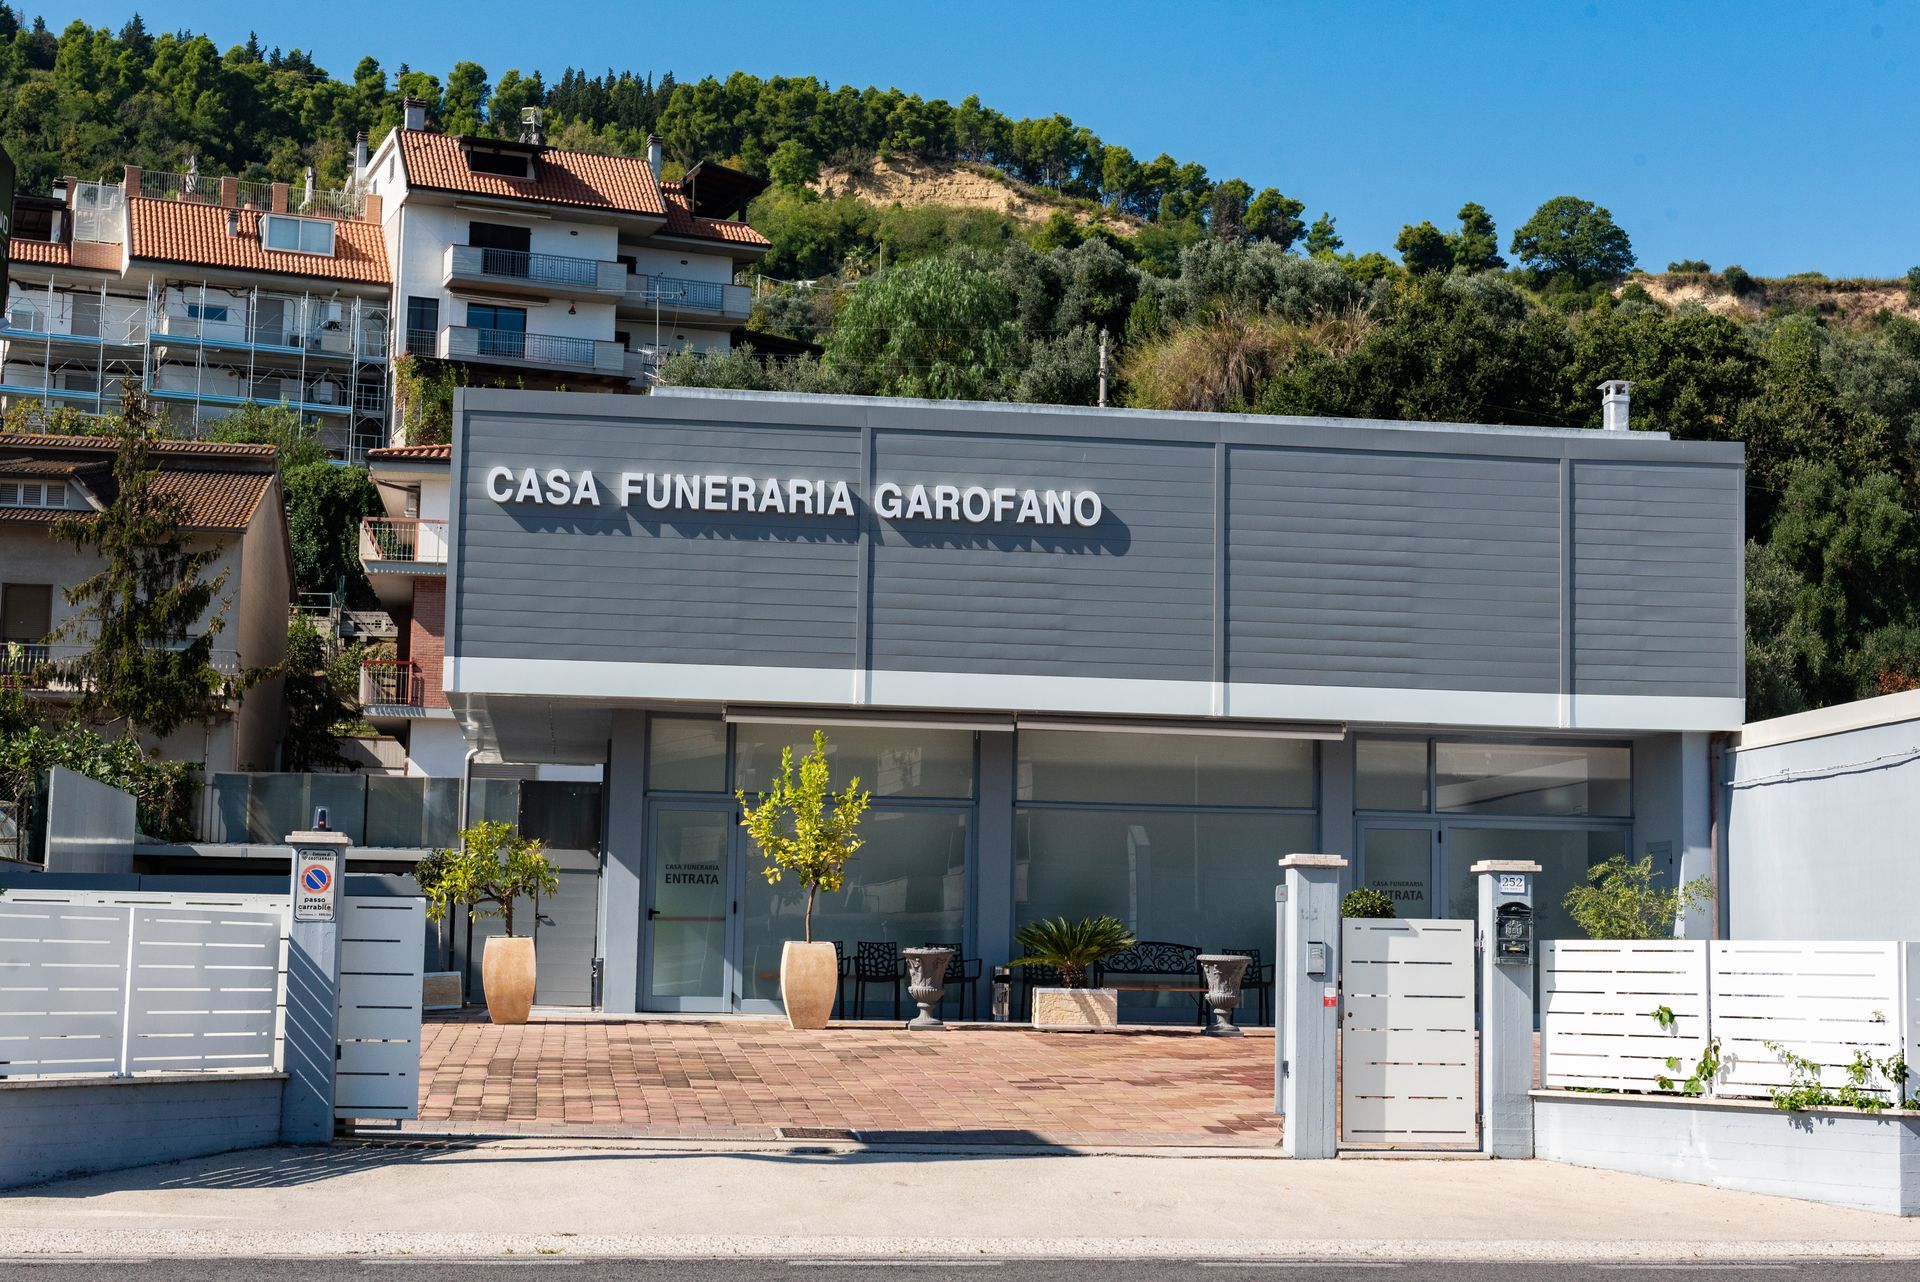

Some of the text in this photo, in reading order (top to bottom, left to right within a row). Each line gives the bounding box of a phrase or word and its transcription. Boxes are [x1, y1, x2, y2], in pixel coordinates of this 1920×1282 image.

[486, 466, 1103, 527] CASA FUNERARIA GAROFANO
[683, 863, 720, 871] FUNERARIA
[665, 873, 719, 885] ENTRATA
[1502, 877, 1523, 887] 252
[1379, 890, 1424, 900] TRATA
